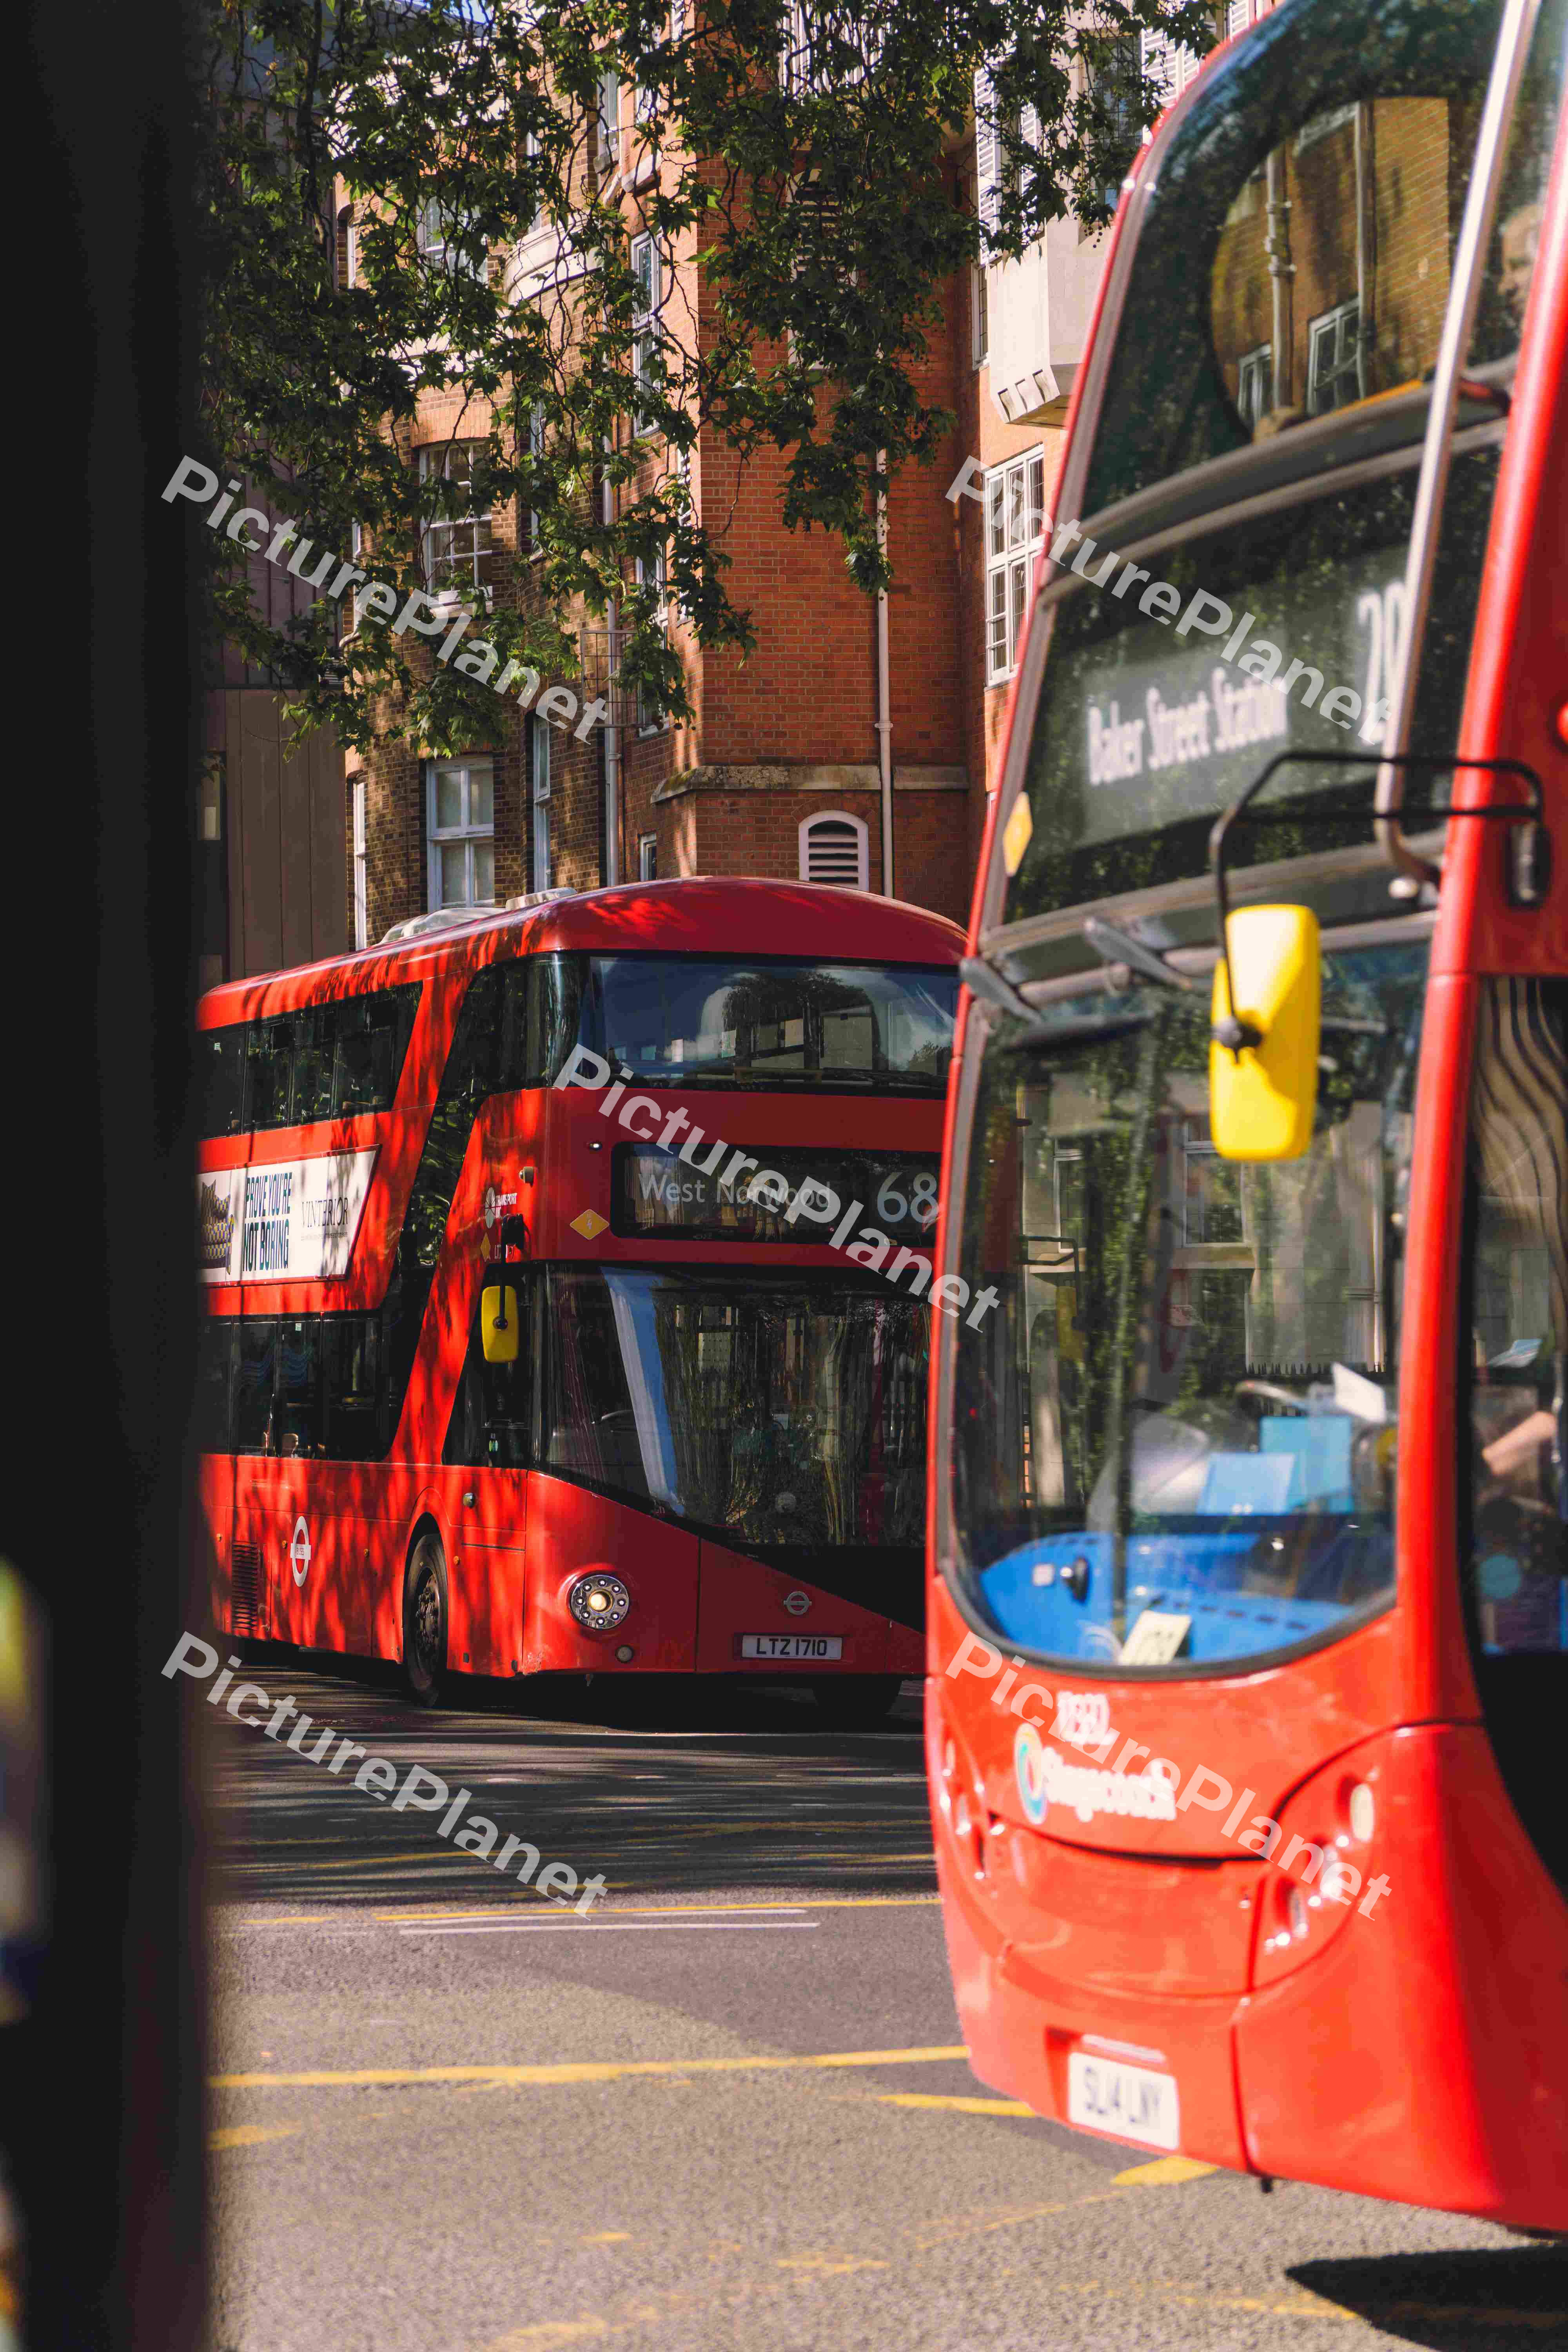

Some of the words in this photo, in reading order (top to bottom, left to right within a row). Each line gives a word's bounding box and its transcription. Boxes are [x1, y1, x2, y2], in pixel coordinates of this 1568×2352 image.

[244, 1175, 268, 1219] PROVE
[268, 1172, 292, 1216] YOU'RE
[301, 1197, 348, 1228] VINTERIOR
[639, 1173, 705, 1203] West
[716, 1175, 831, 1208] Norwood
[877, 1172, 939, 1223] 68
[242, 1222, 259, 1272] NOT
[259, 1219, 289, 1271] BORING
